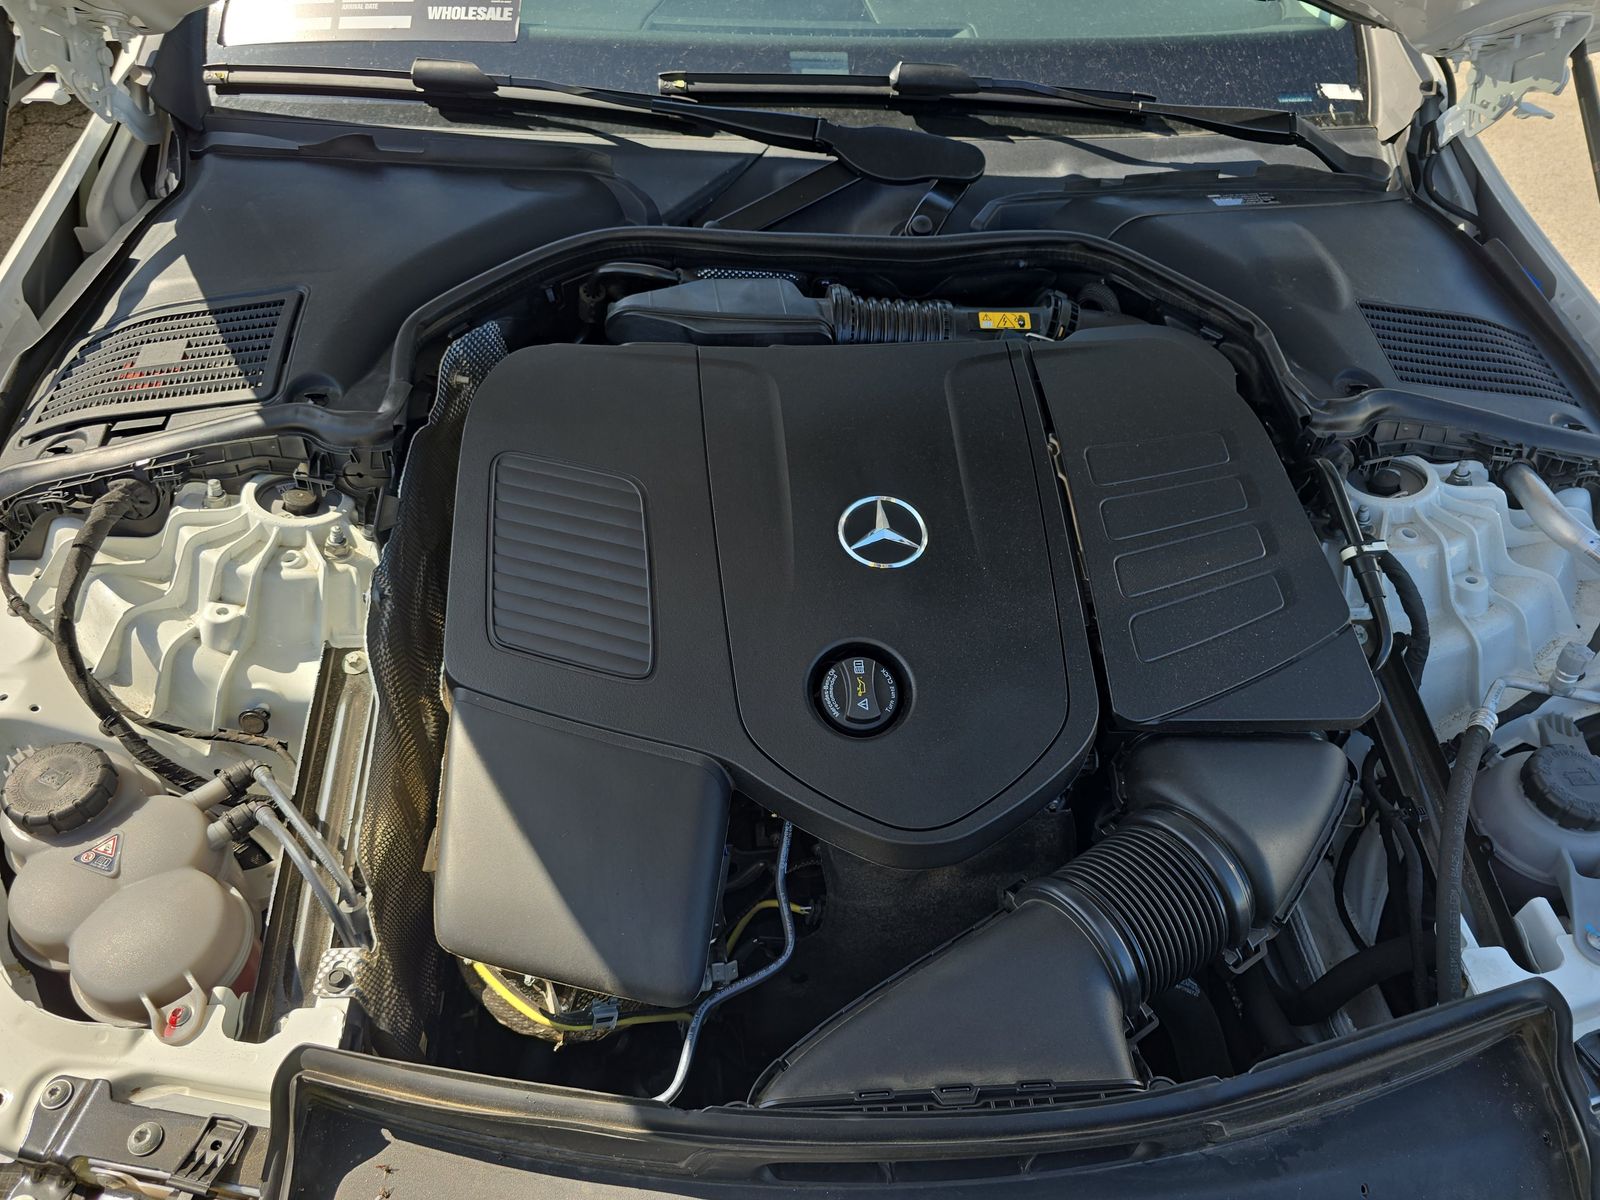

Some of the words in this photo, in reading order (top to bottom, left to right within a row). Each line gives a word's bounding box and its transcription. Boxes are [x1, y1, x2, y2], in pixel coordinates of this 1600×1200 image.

[427, 6, 513, 21] WHOLESALE
[880, 668, 894, 684] CLICK
[823, 676, 840, 718] Mercedes-Benz
[829, 674, 841, 710] recommended
[885, 699, 895, 713] Turn
